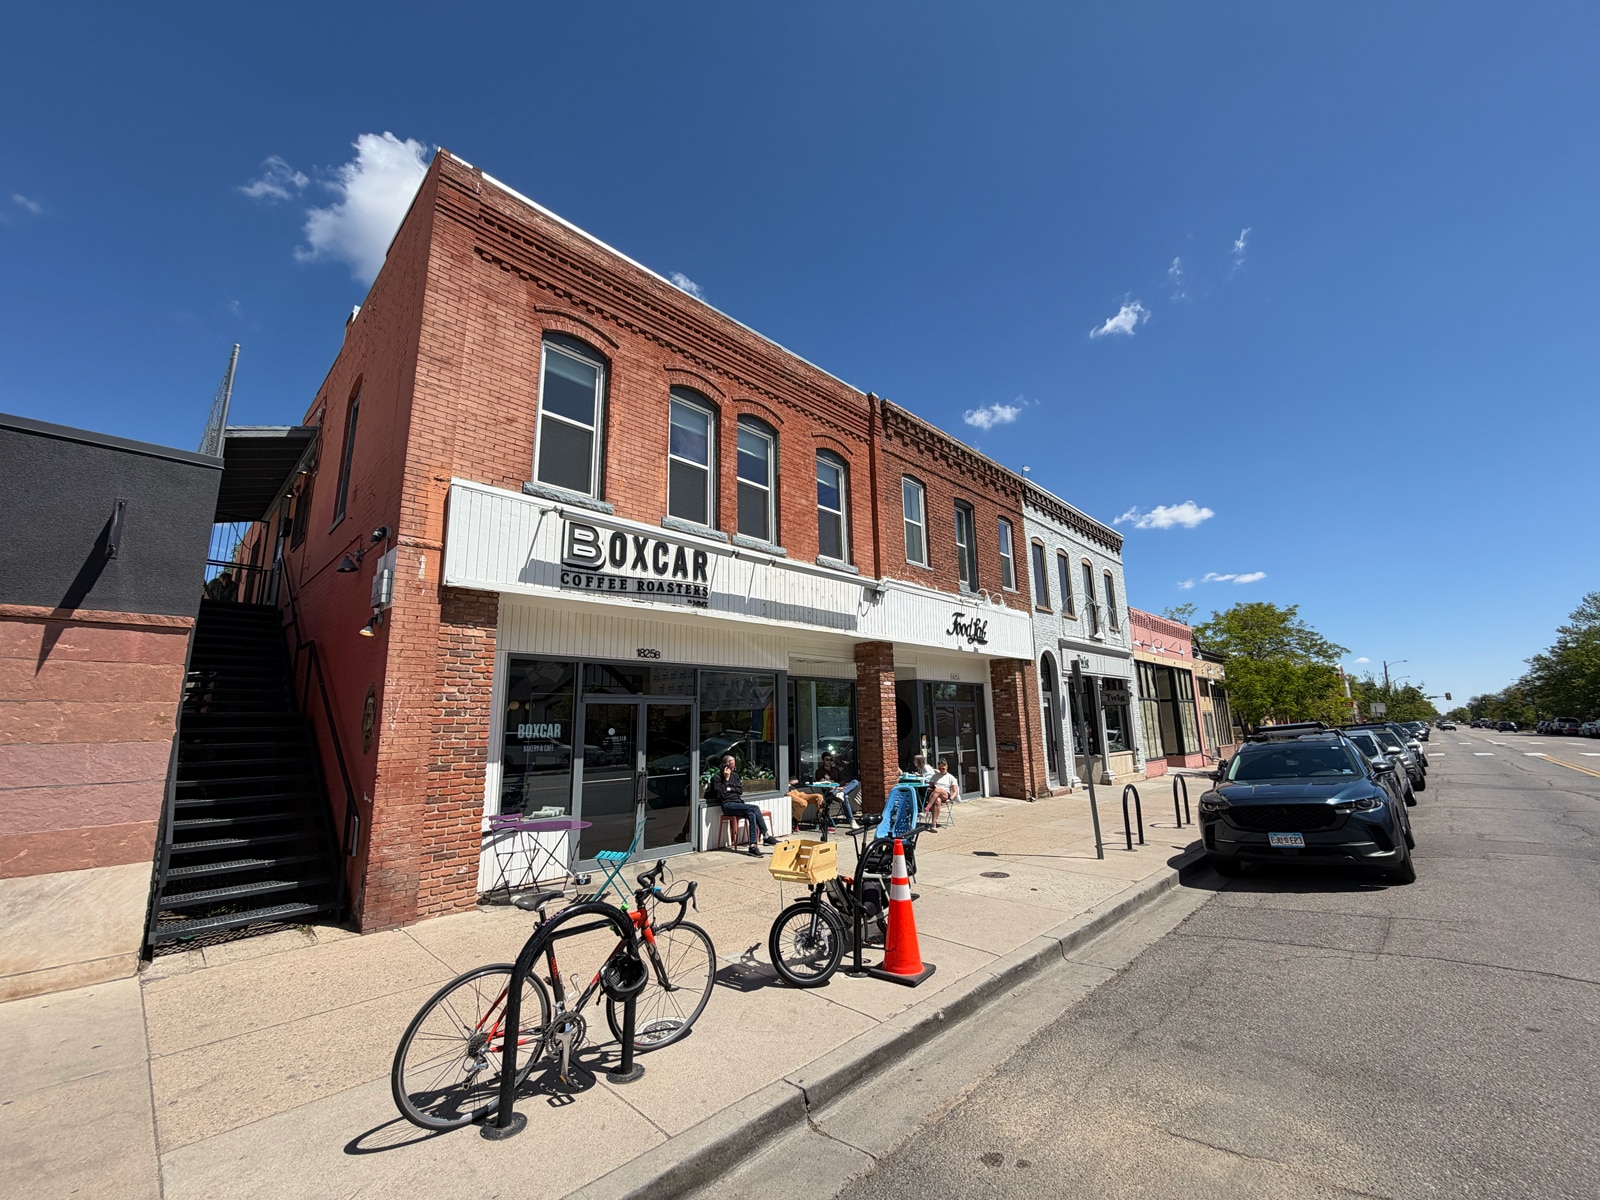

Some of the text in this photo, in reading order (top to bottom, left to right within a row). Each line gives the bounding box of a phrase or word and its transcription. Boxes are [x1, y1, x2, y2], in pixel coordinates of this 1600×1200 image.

[562, 520, 709, 583] BOXCAR
[561, 572, 709, 597] COFFEE ROASTERS
[946, 612, 974, 638] Food
[1105, 694, 1126, 703] Twig
[517, 723, 562, 739] BOXCAR
